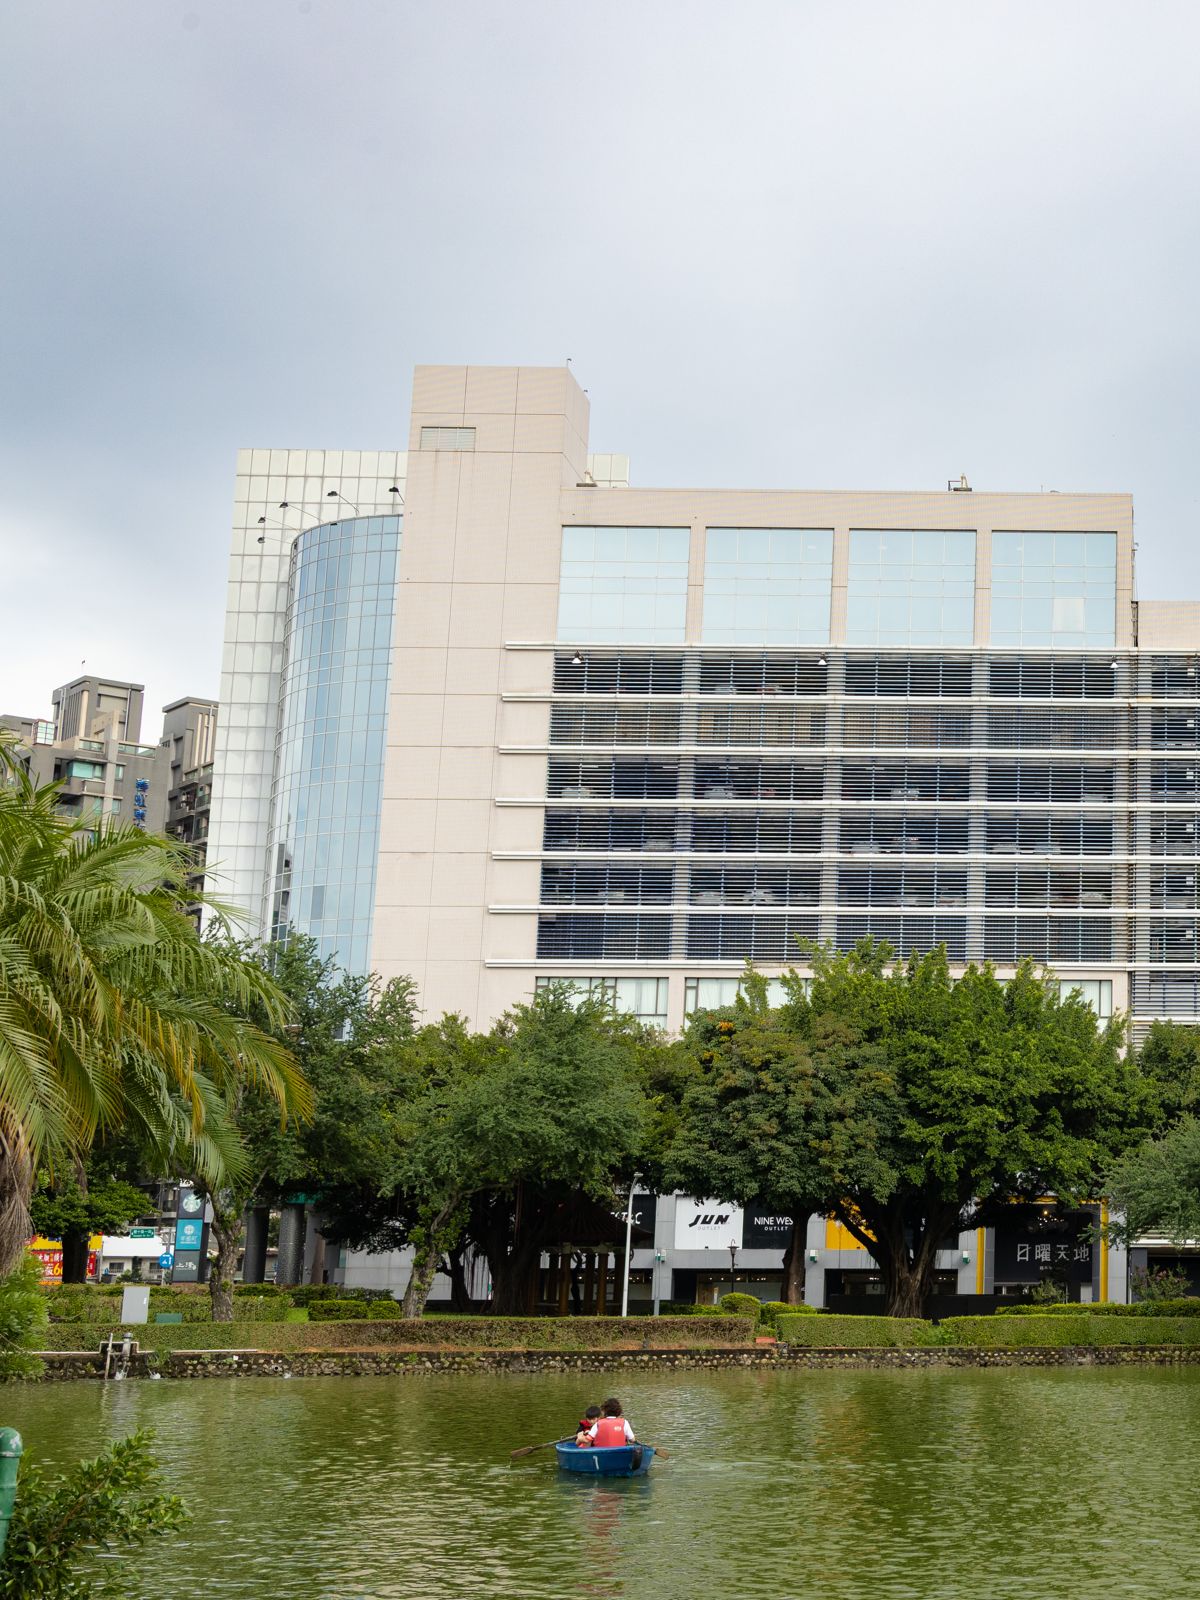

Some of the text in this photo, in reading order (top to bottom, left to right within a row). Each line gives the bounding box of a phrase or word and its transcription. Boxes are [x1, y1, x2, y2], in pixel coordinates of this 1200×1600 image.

[688, 1215, 730, 1227] JUN
[754, 1217, 776, 1225] NINE
[1017, 1244, 1089, 1262] 日曜天地
